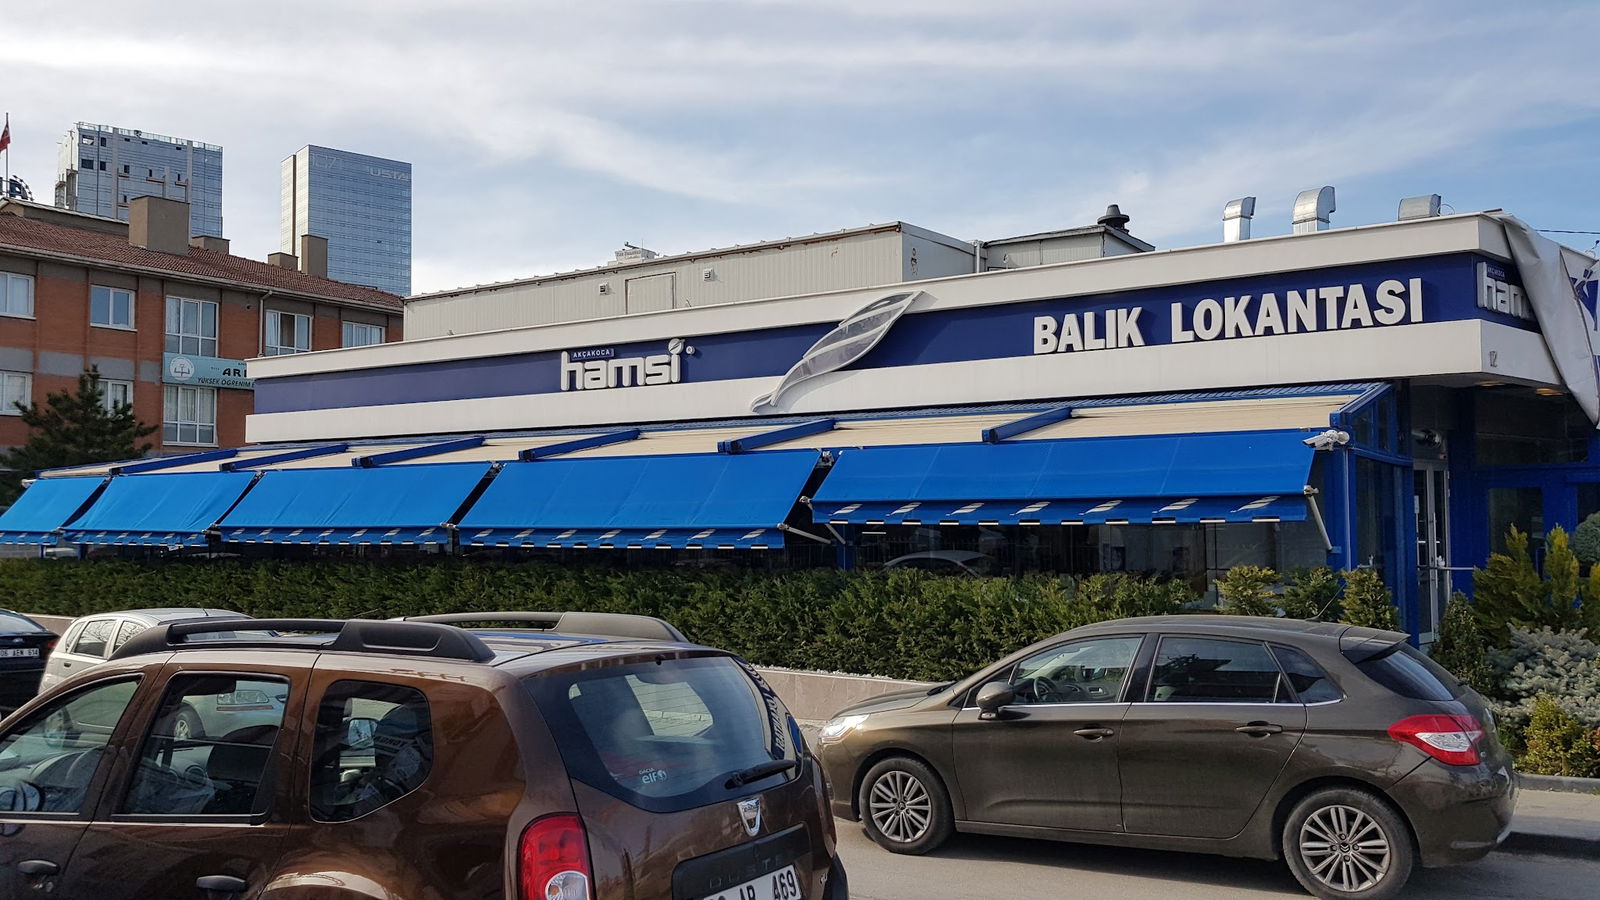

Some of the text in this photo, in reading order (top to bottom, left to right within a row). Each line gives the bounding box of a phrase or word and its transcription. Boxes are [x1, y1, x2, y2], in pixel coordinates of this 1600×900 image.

[1033, 277, 1424, 355] BALIK LOKANTASI
[560, 338, 684, 392] hamsi
[572, 349, 611, 359] AKÇAKOCA
[772, 870, 797, 900] 469
